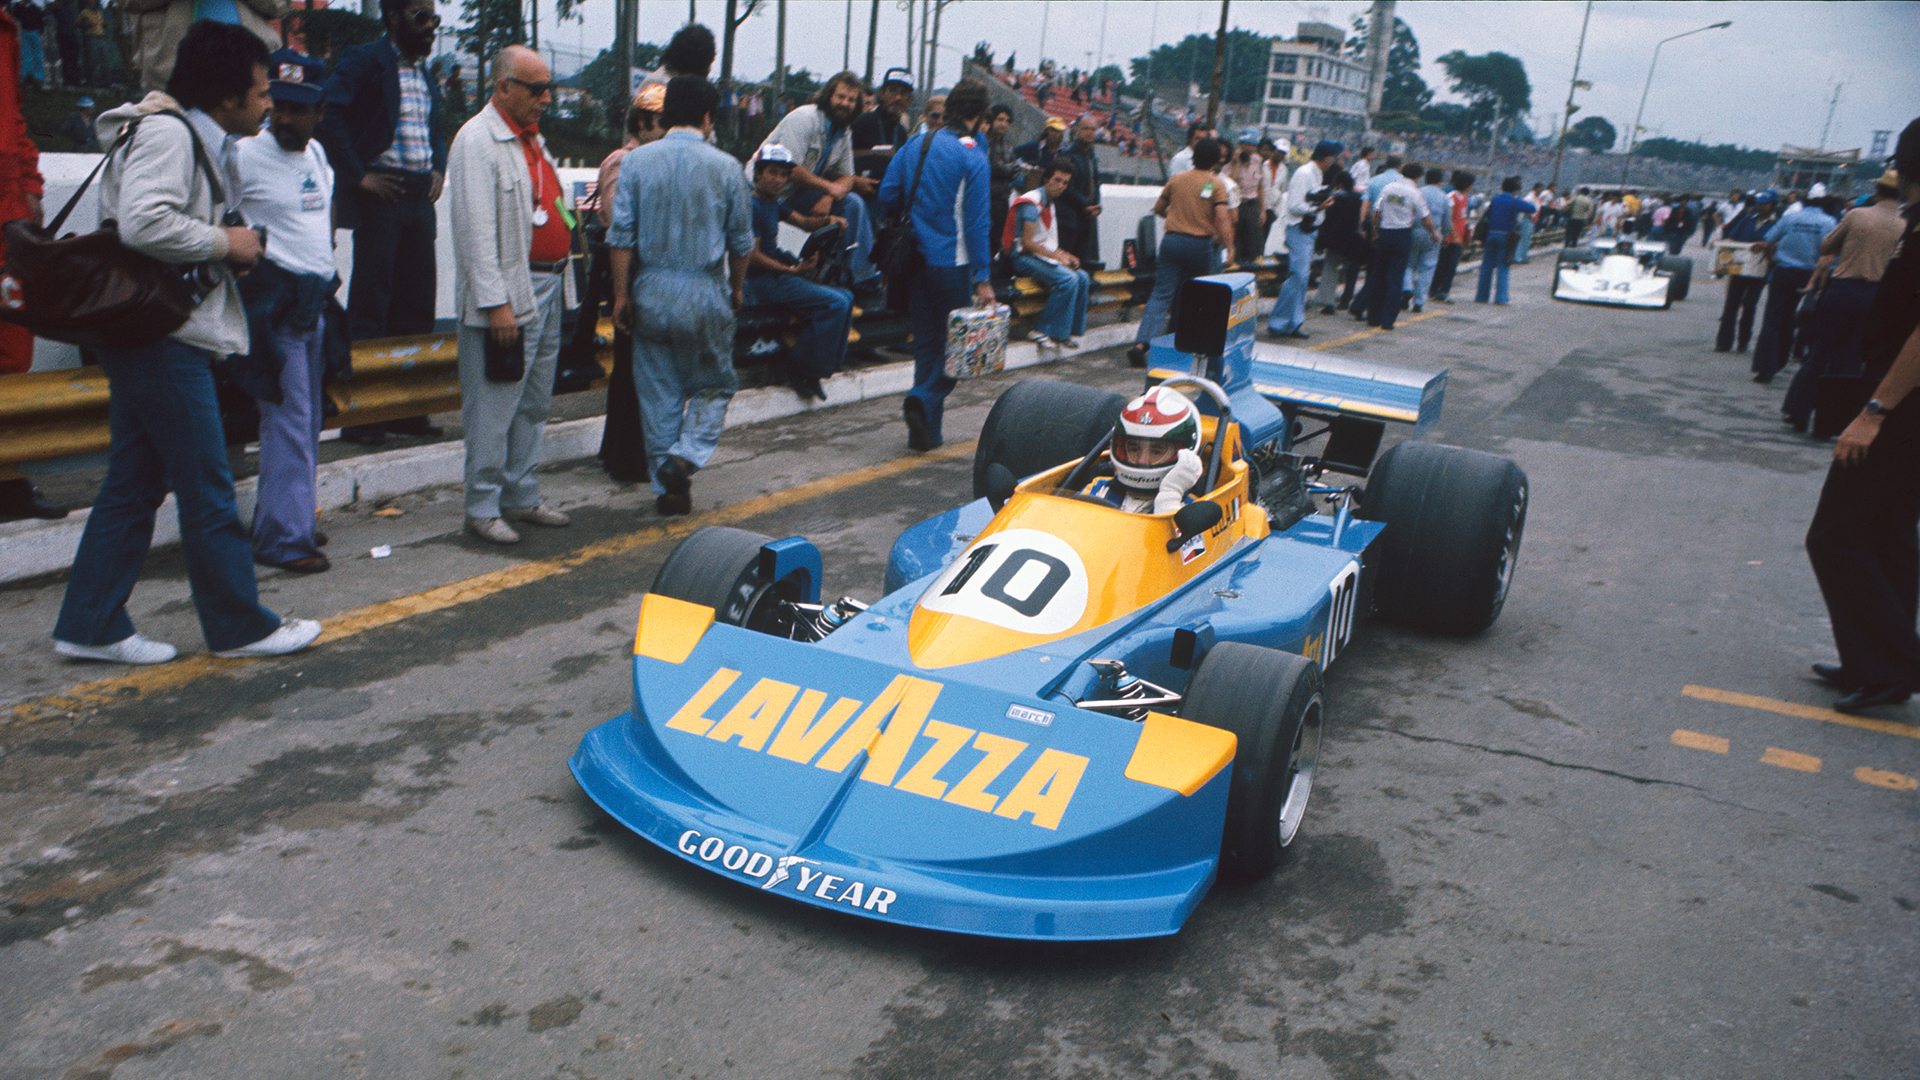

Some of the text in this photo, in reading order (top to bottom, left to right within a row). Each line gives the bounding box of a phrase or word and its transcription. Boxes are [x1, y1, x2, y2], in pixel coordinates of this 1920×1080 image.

[1593, 279, 1631, 294] 34
[939, 543, 1071, 617] 10
[1326, 572, 1355, 665] 10
[664, 667, 1090, 830] LAVAZZA
[1010, 708, 1050, 724] march
